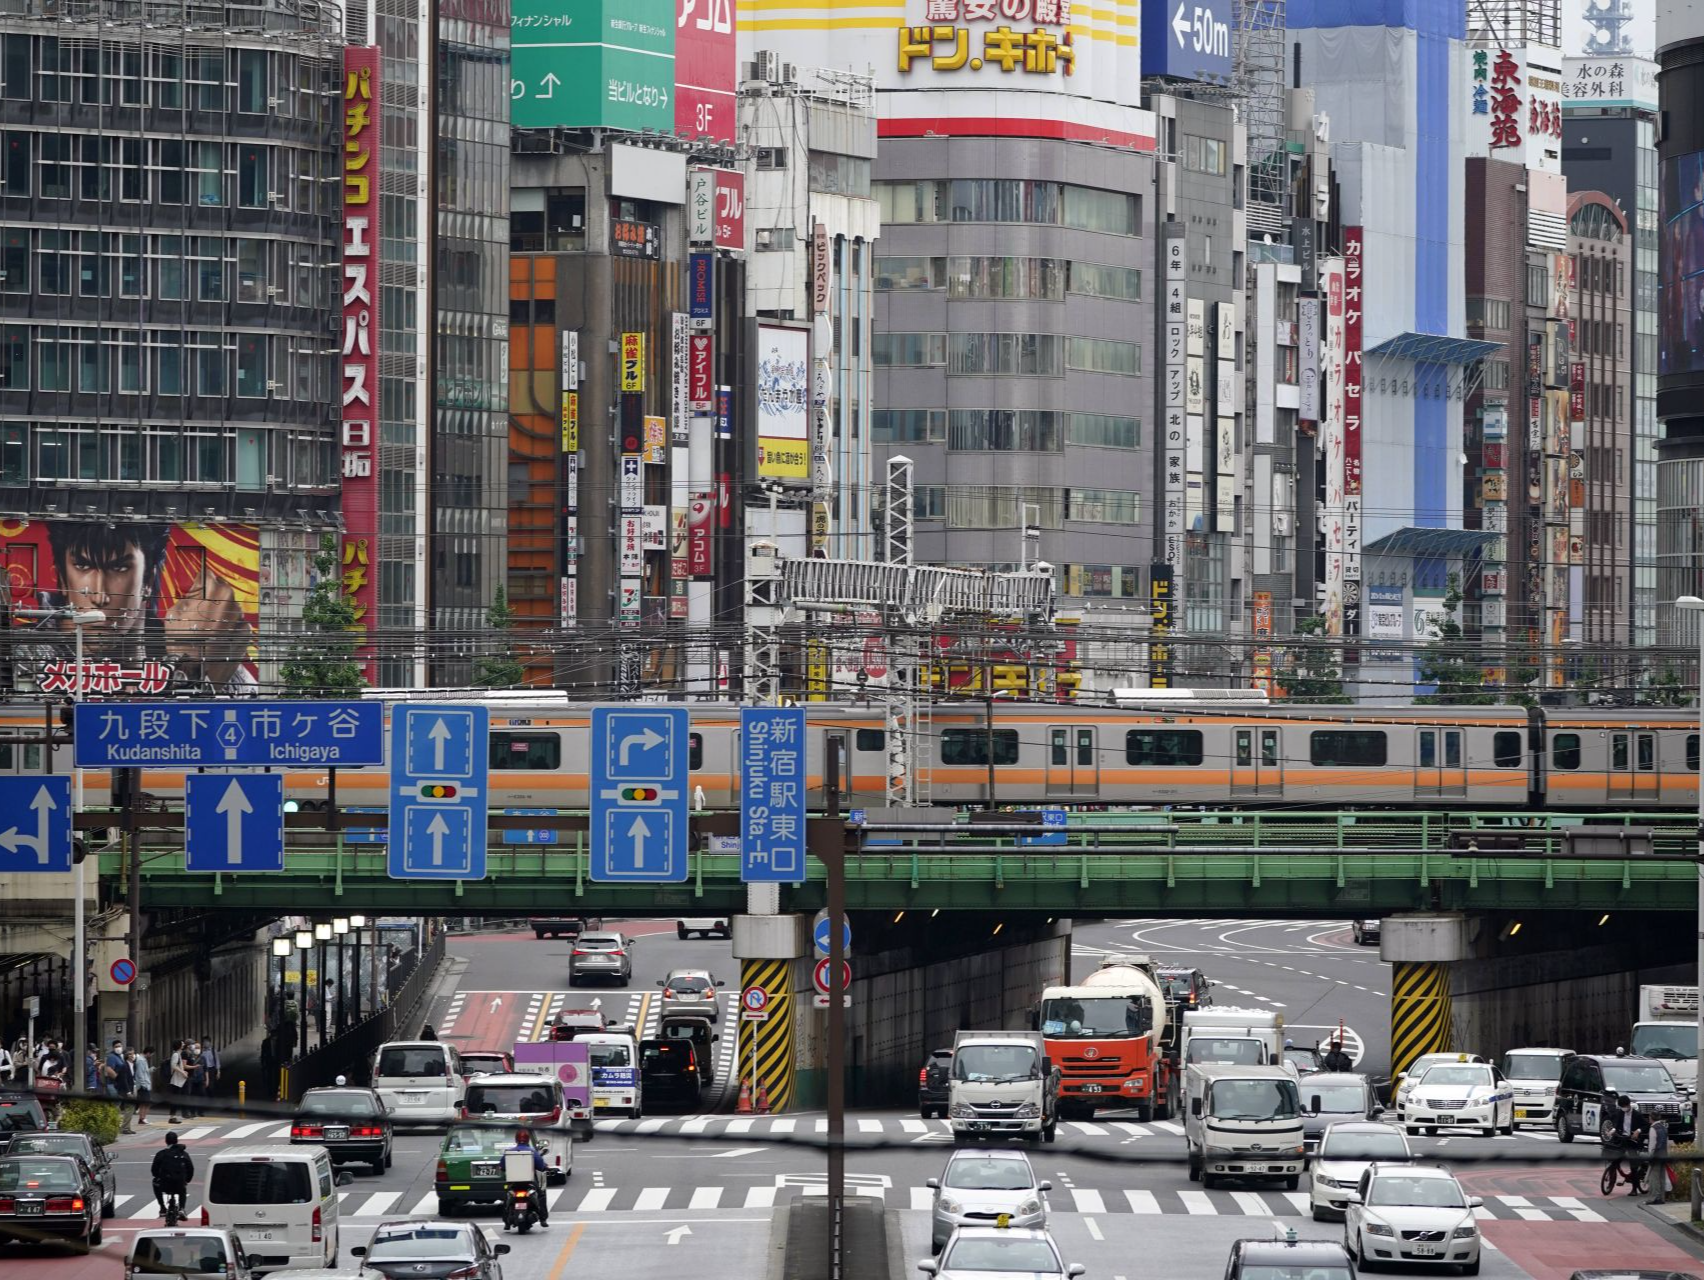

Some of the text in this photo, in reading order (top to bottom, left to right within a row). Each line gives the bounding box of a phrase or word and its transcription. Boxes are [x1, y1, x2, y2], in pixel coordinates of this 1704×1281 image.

[1193, 6, 1229, 57] 50m
[1577, 62, 1624, 80] 水の森
[608, 78, 659, 107] 当ビルとなり
[1488, 49, 1522, 147] 東海苑
[696, 103, 713, 131] 3F
[341, 66, 372, 478] パチンコ エスパス 日拓
[695, 259, 706, 303] PROMISE
[695, 319, 706, 327] 6F
[1345, 240, 1361, 431] カラオケ パセラ
[695, 351, 707, 399] アイフル
[695, 402, 706, 410] 5F
[1169, 413, 1181, 484] 北の家族
[694, 528, 705, 563] アコム
[41, 660, 174, 693] メガホール
[99, 709, 211, 741] 九段下
[225, 727, 237, 743] 4
[107, 744, 201, 760] Kudanshita
[270, 743, 340, 762] Ichigaya
[749, 721, 768, 799] Shinjuku
[770, 716, 797, 871] 新宿駅東口
